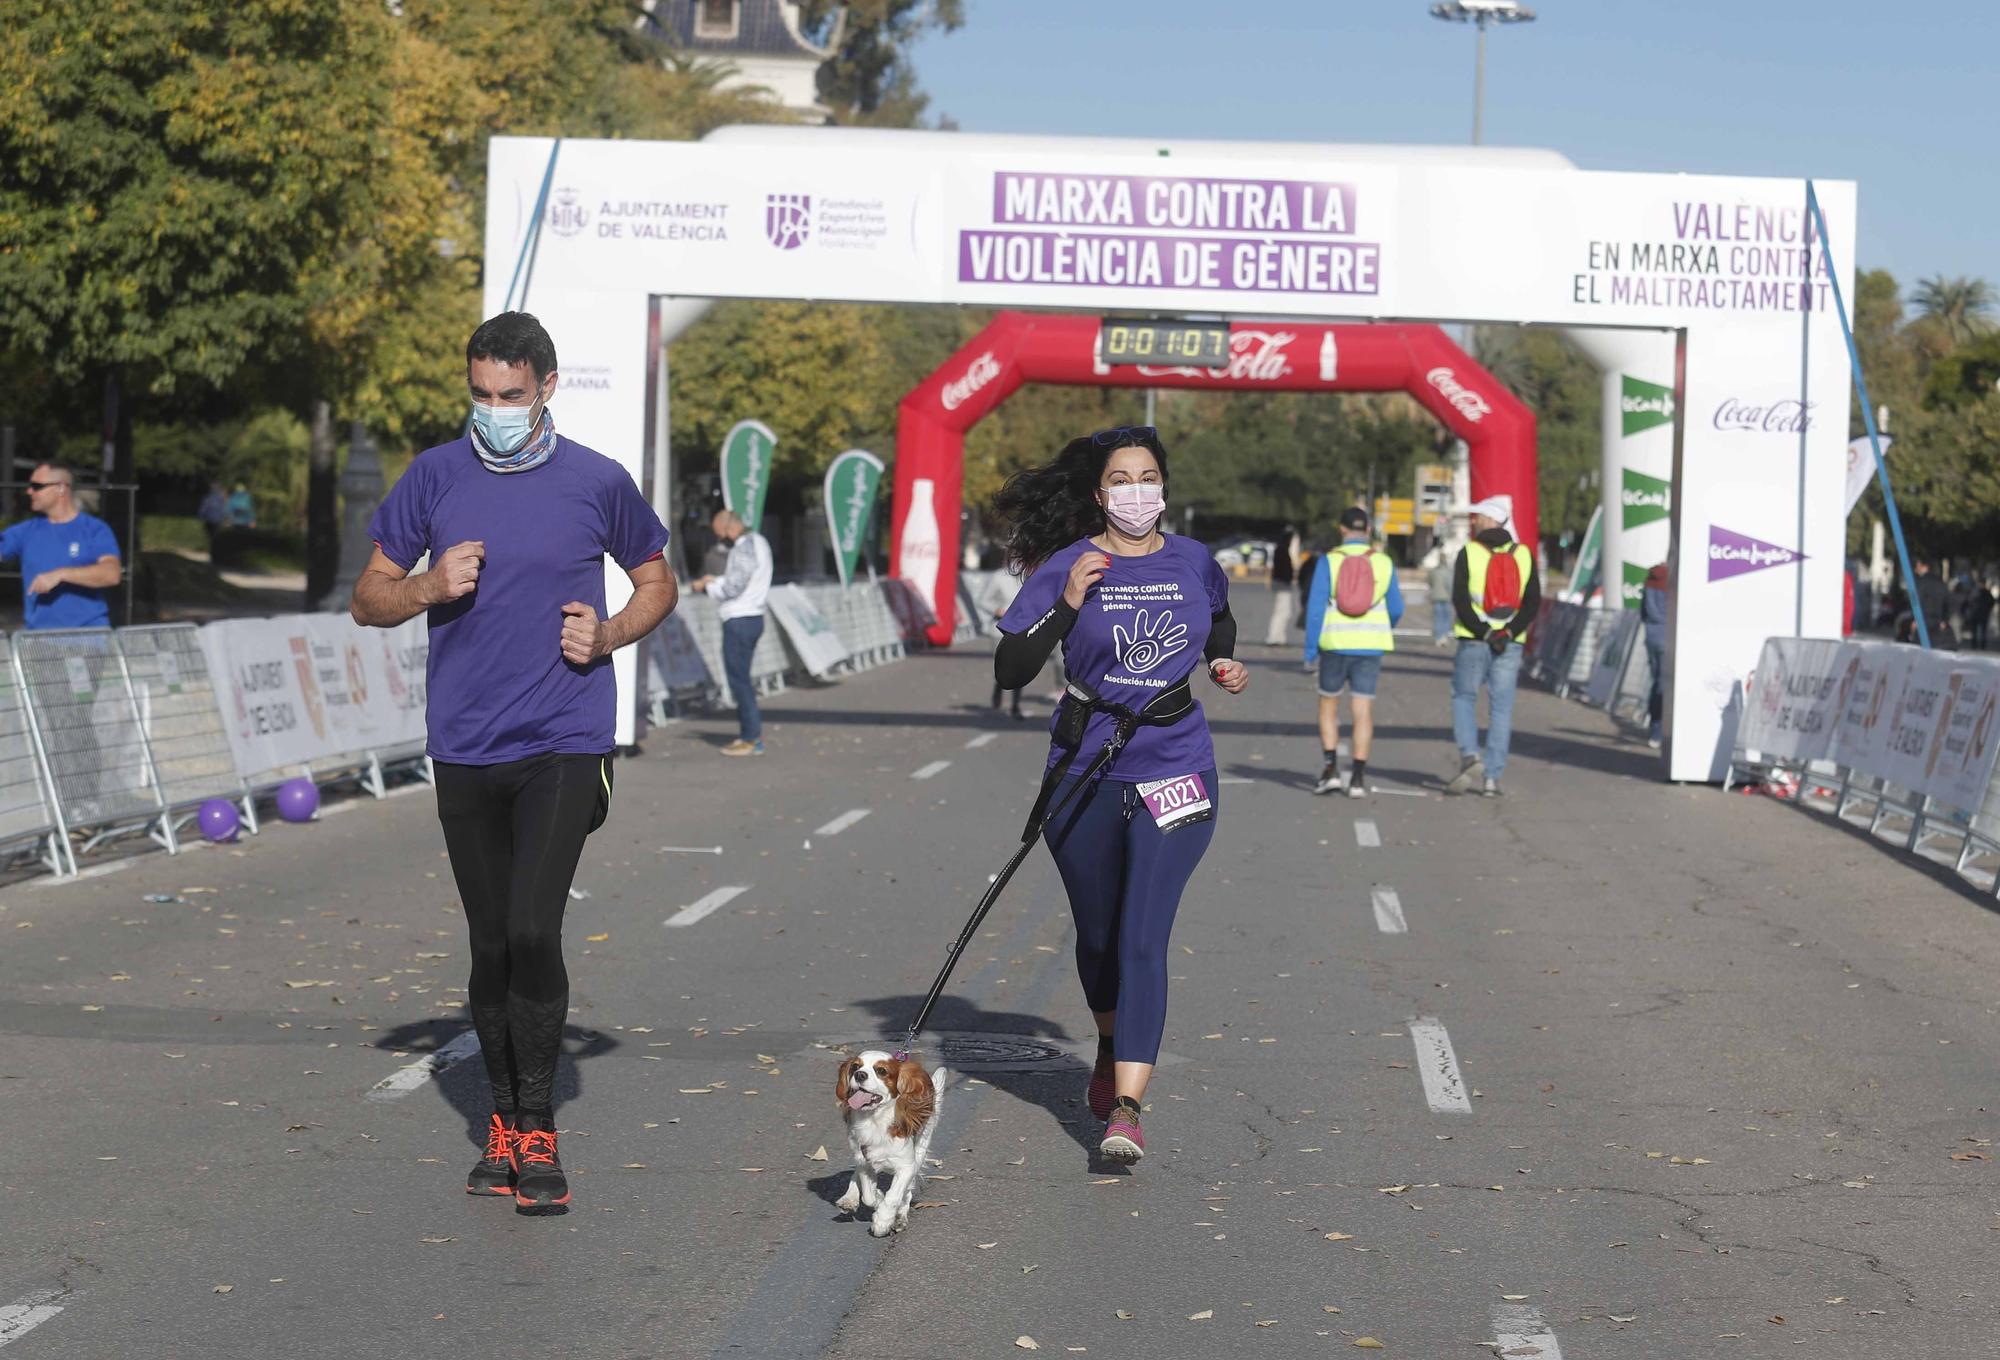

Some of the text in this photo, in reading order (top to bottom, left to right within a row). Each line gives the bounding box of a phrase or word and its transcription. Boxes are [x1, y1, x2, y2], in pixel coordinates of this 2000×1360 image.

[599, 200, 730, 219] AJUNTAMENT
[1004, 176, 1346, 233] MARXA CONTRA LA
[598, 222, 728, 241] DE VALÈNCIA
[968, 232, 1378, 293] VIOLÈNCIA DE GÈNERE
[1588, 241, 1830, 279] EN MARXA CONTRA
[1573, 274, 1830, 312] EL MALTRACTAMENT
[1140, 583, 1179, 593] CONTIGO
[1172, 592, 1184, 601] de
[1102, 602, 1136, 612] género.
[1103, 674, 1144, 687] Asociación
[1152, 778, 1201, 814] 2021
